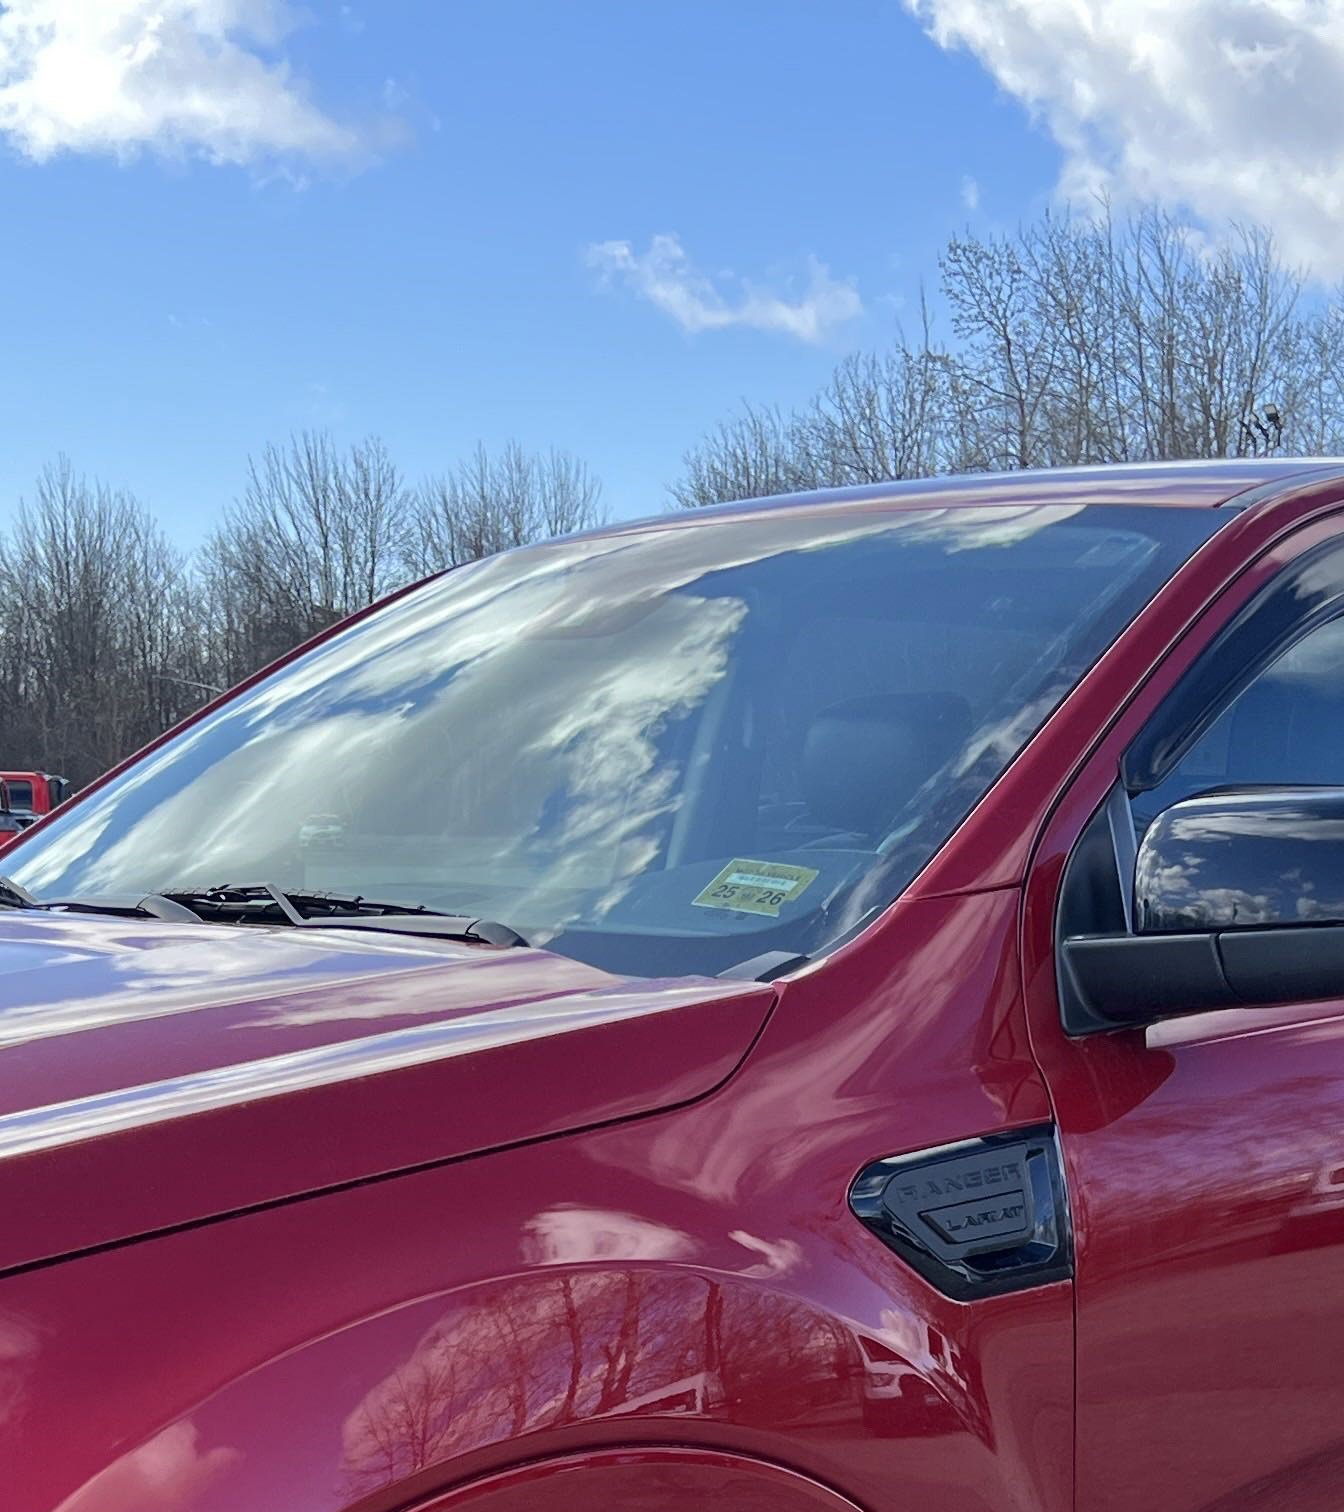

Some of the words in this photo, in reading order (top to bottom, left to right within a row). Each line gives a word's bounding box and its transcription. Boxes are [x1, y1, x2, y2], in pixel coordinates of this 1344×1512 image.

[711, 884, 740, 899] 25
[756, 890, 786, 906] 26
[897, 1162, 1022, 1202] RANGER
